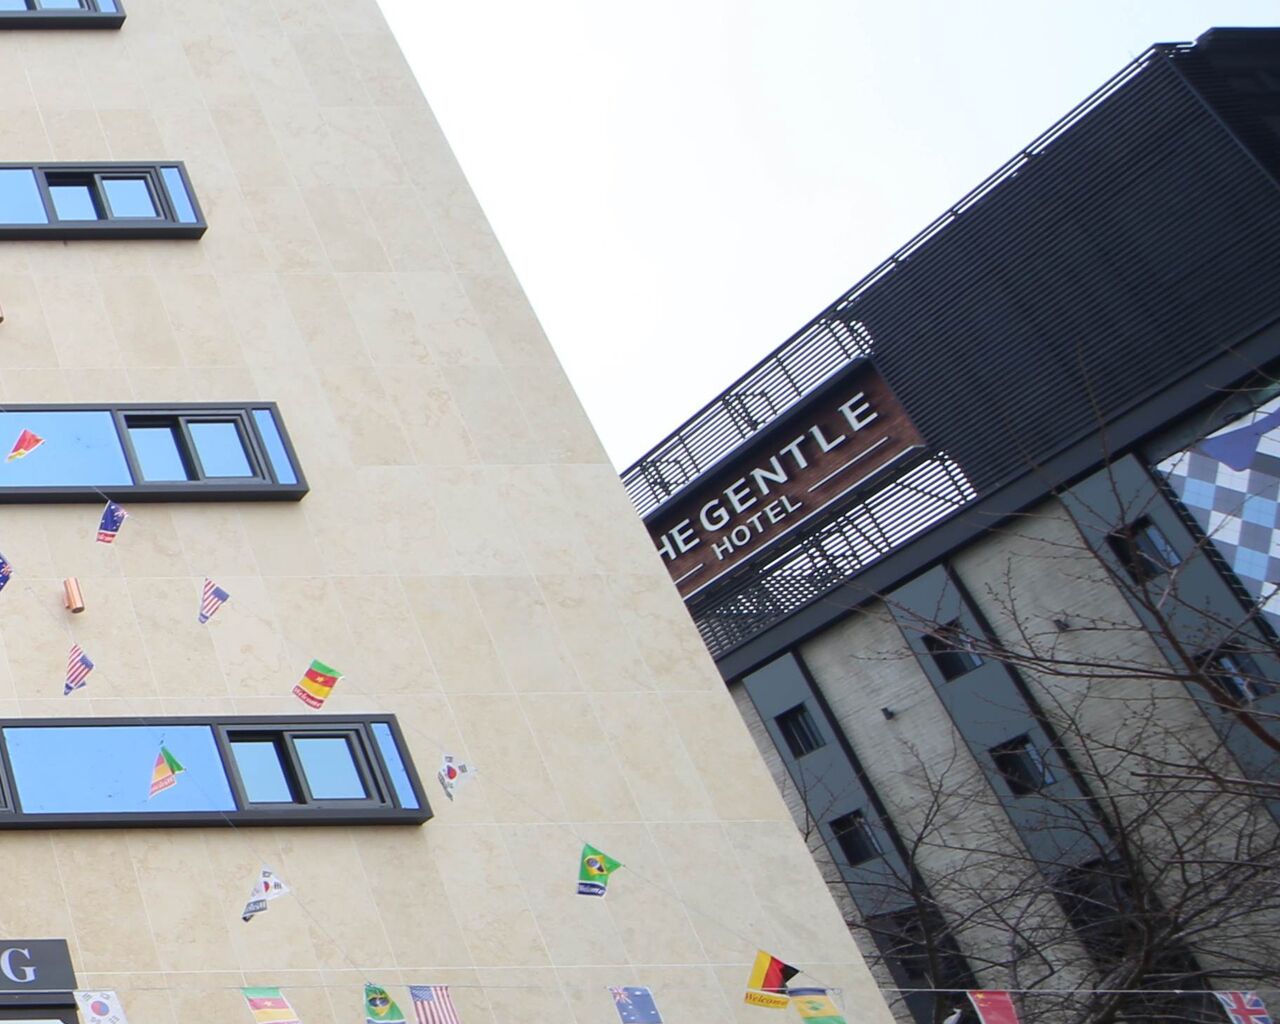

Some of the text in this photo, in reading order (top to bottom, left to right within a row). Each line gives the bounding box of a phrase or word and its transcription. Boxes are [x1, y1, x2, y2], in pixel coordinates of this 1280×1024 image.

[656, 391, 879, 562] HE GENTLE
[711, 494, 803, 561] HOTEL
